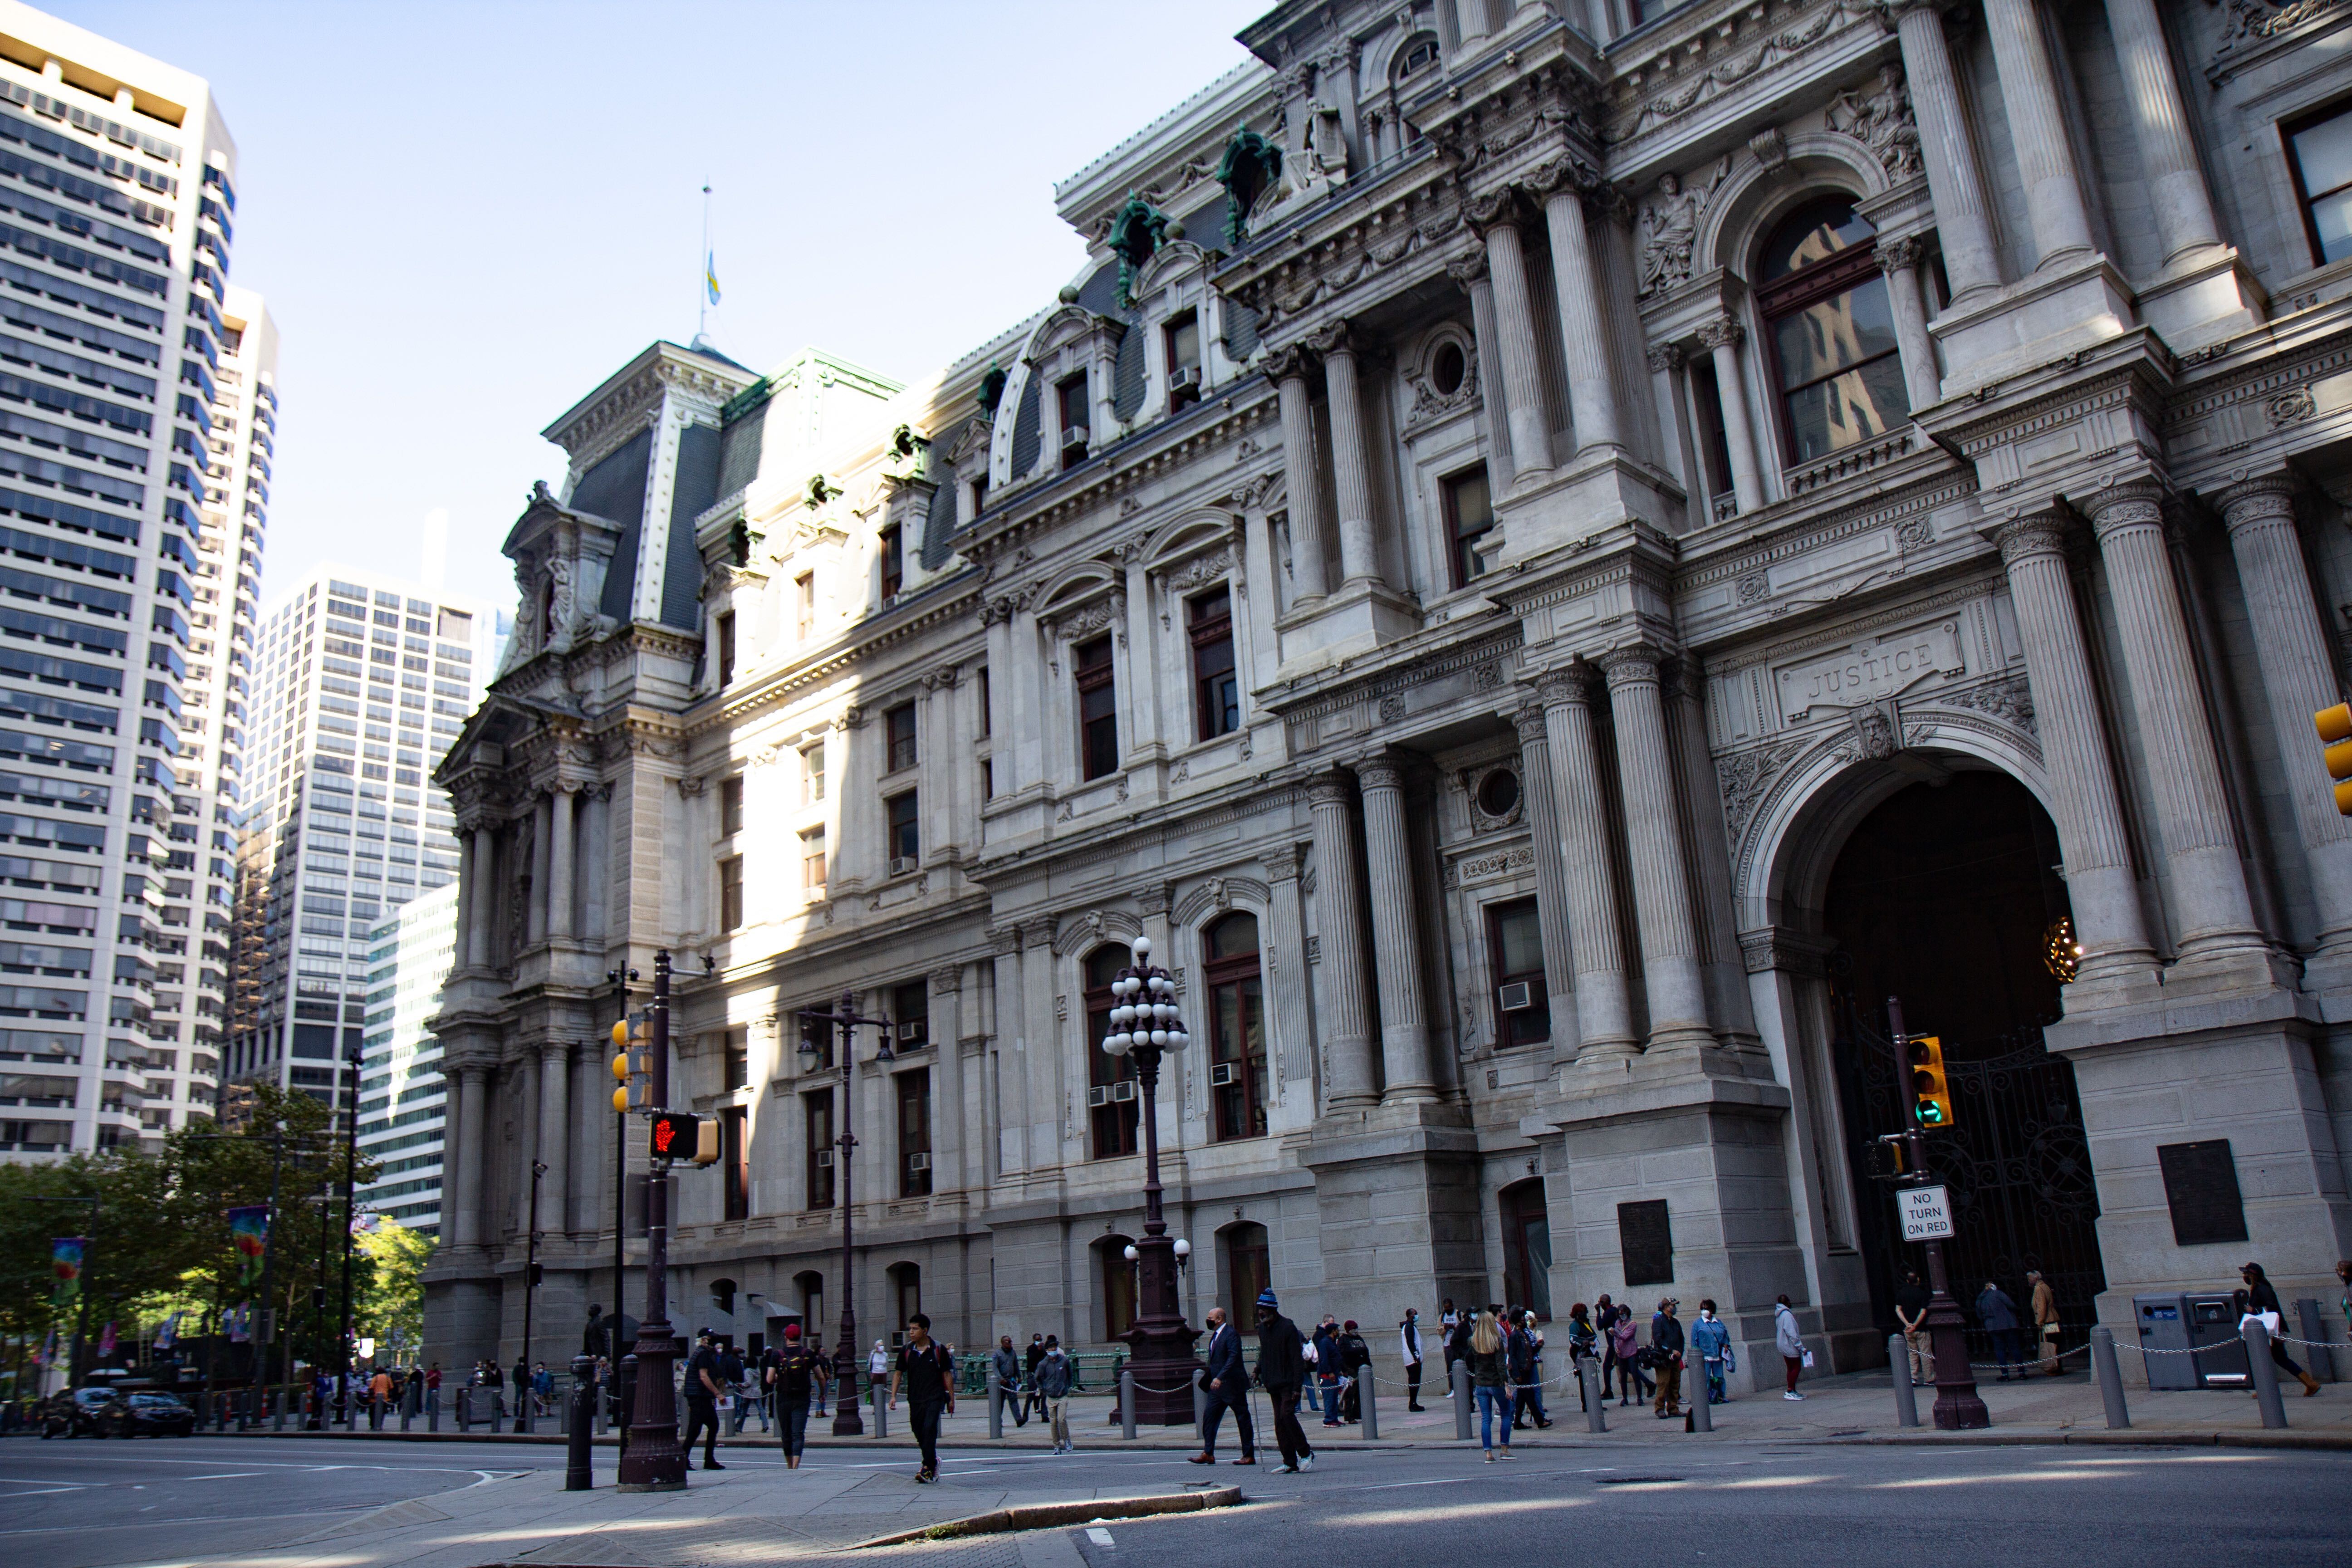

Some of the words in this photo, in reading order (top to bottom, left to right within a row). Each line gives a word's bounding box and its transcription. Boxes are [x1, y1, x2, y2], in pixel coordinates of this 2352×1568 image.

[1808, 643, 1932, 698] JUSTICE
[1913, 1194, 1931, 1204] NO
[1909, 1207, 1941, 1219] TURN
[1908, 1224, 1923, 1234] ON
[1927, 1221, 1947, 1232] RED
